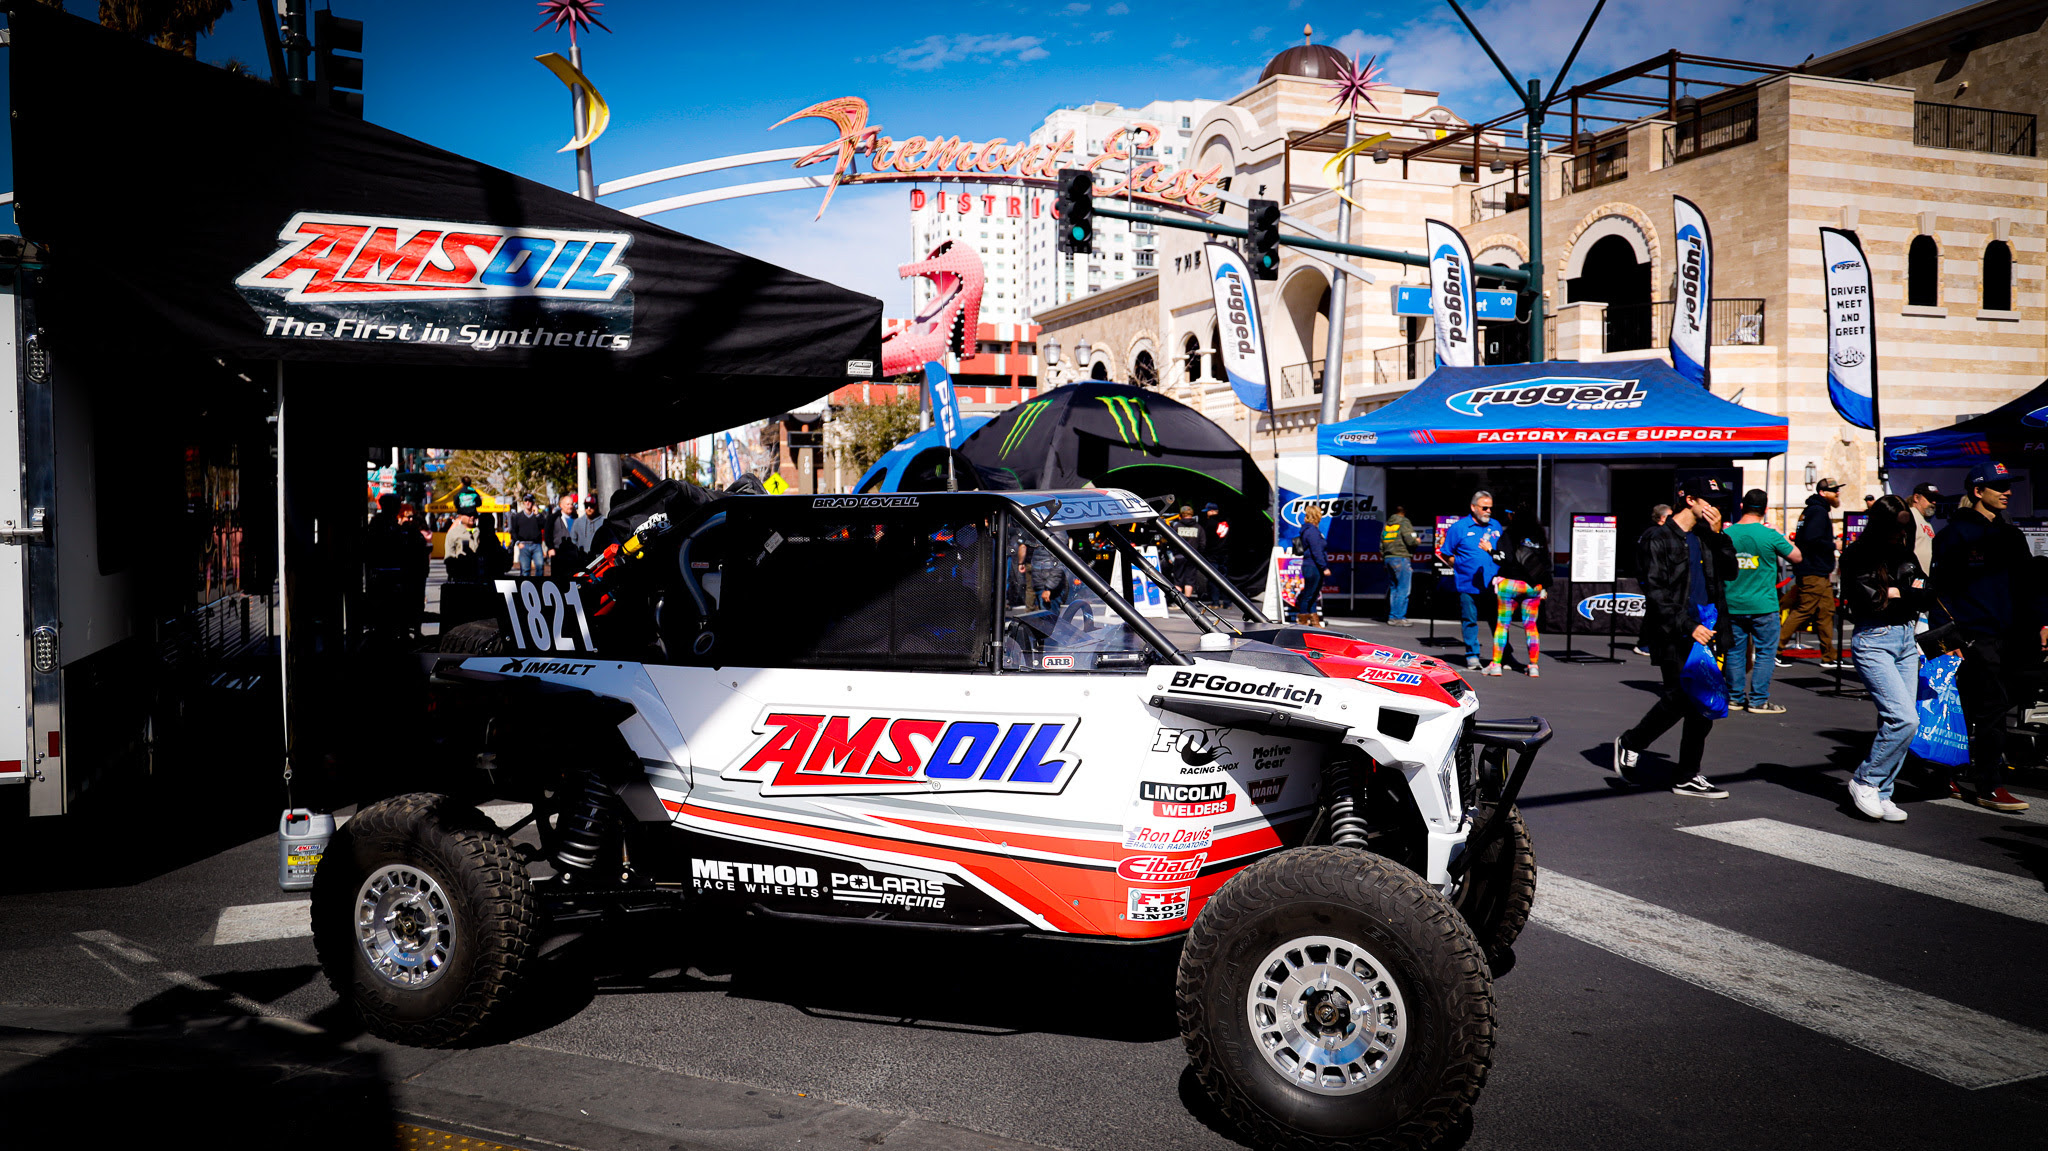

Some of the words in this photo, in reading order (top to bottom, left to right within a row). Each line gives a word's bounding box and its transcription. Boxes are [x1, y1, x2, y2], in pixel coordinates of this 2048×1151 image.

[768, 96, 1076, 222] Fremont
[1086, 122, 1222, 206] East
[911, 188, 1060, 220] DISTRIC
[265, 222, 620, 294] AMSOIL
[1175, 250, 1202, 275] THE
[1831, 285, 1867, 296] DRIVER
[1837, 299, 1862, 309] MEET
[1841, 313, 1860, 322] AND
[265, 316, 326, 338] The
[334, 319, 412, 341] First
[422, 323, 450, 343] in
[457, 324, 631, 351] Synthetics
[1836, 326, 1865, 336] GREET
[1567, 400, 1642, 410] radios
[1477, 431, 1568, 442] FACTORY
[1574, 431, 1629, 441] RACE
[1635, 429, 1737, 441] SUPPORT
[812, 498, 858, 508] BRAD
[860, 497, 920, 507] LOVELL
[1360, 553, 1383, 561] RA
[494, 579, 595, 652] T821
[1046, 658, 1071, 666] ARB
[1359, 668, 1421, 685] AMSOIL
[1170, 671, 1322, 706] BFGoodrich
[738, 712, 1068, 787] AMSOIL
[1152, 727, 1233, 757] FOX
[1252, 745, 1292, 759] Motive
[1180, 766, 1215, 775] RACING
[1217, 762, 1240, 773] SHOX
[1254, 758, 1285, 770] Gear
[1144, 783, 1223, 801] LINCOLN
[1252, 784, 1280, 798] WARN
[1161, 801, 1228, 817] WELDERS
[1137, 828, 1170, 843] Ron
[1172, 826, 1212, 843] Davis
[1133, 841, 1165, 850] RACING
[1167, 840, 1209, 850] RADIATORS
[691, 858, 819, 887] METHOD
[1118, 854, 1205, 880] Eibach
[693, 878, 735, 892] RACE
[745, 884, 820, 898] WHEELS
[831, 872, 946, 896] POLARIS
[881, 893, 946, 909] RACING
[1138, 890, 1187, 905] FK
[1131, 909, 1185, 920] ENDS
[1145, 903, 1186, 913] ROD
